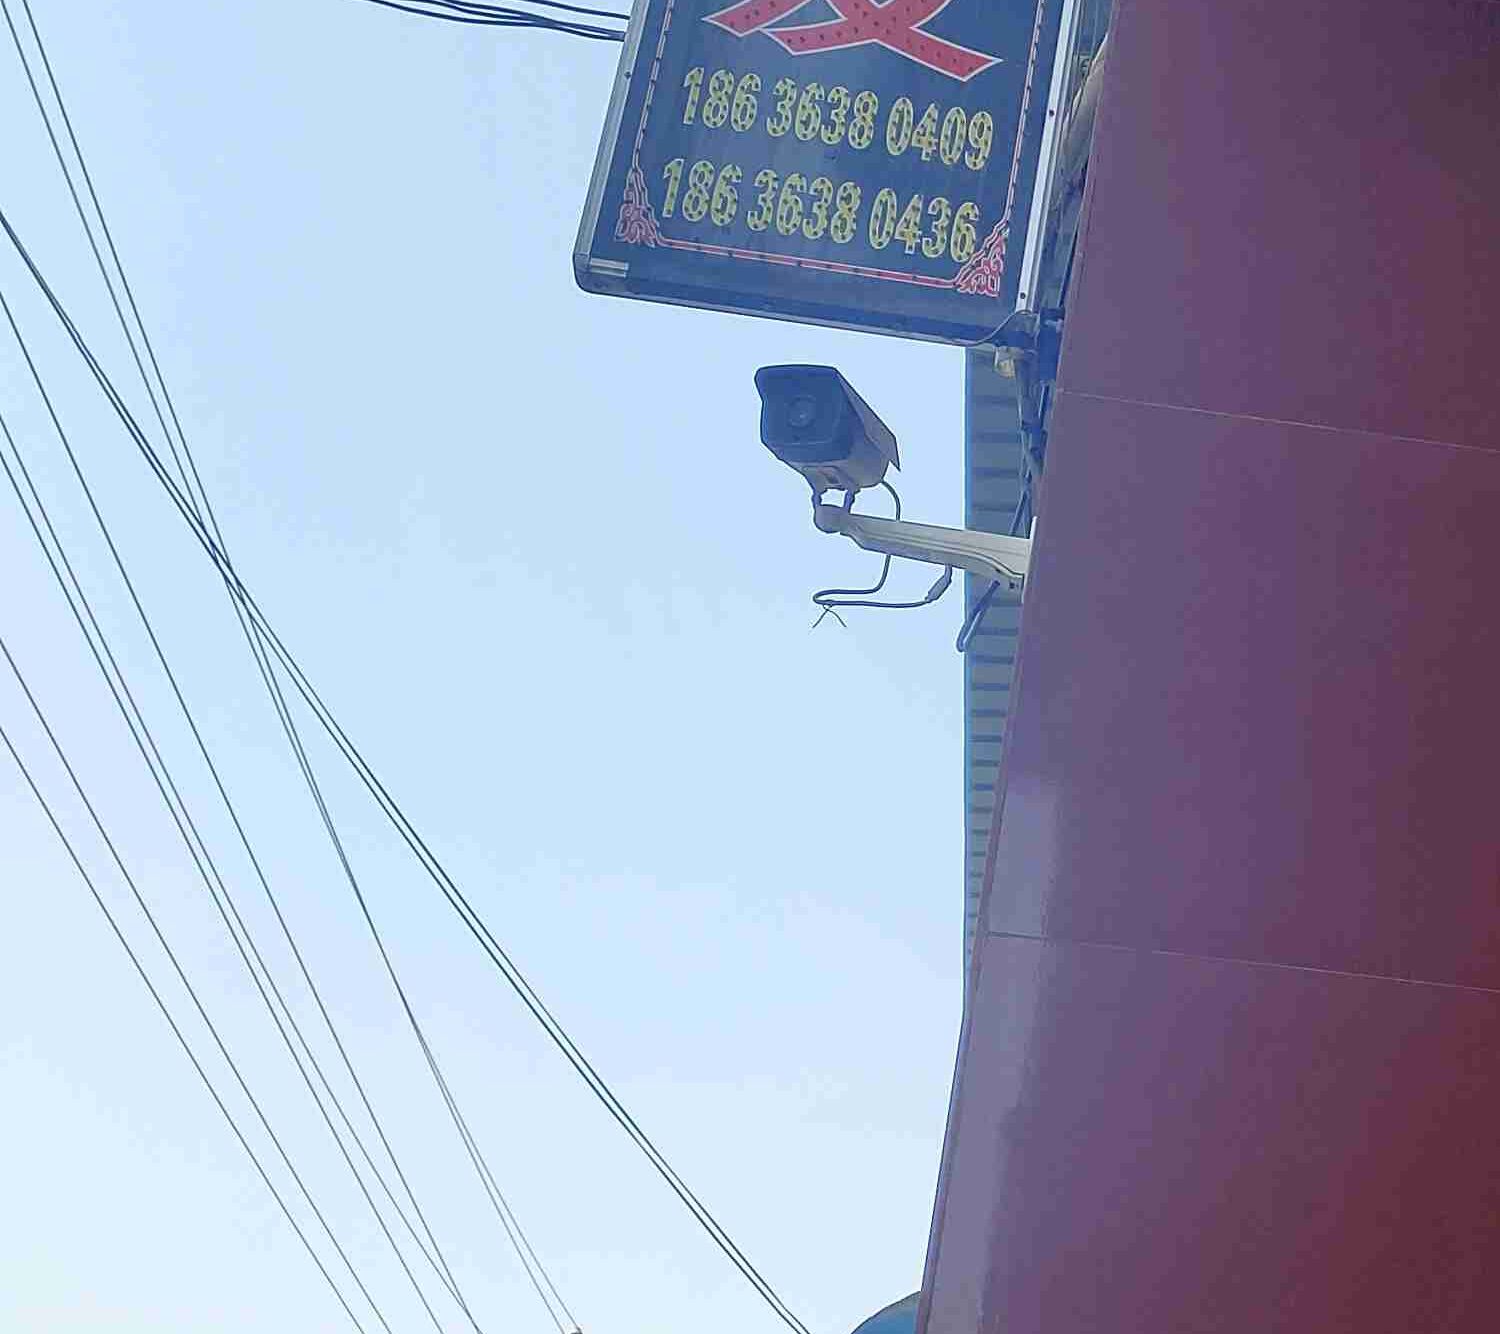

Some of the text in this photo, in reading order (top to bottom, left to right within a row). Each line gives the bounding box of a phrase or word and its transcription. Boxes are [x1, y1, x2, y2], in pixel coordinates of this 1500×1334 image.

[683, 67, 993, 170] 186 3638 0409
[662, 158, 981, 262] 186 3638 0436
